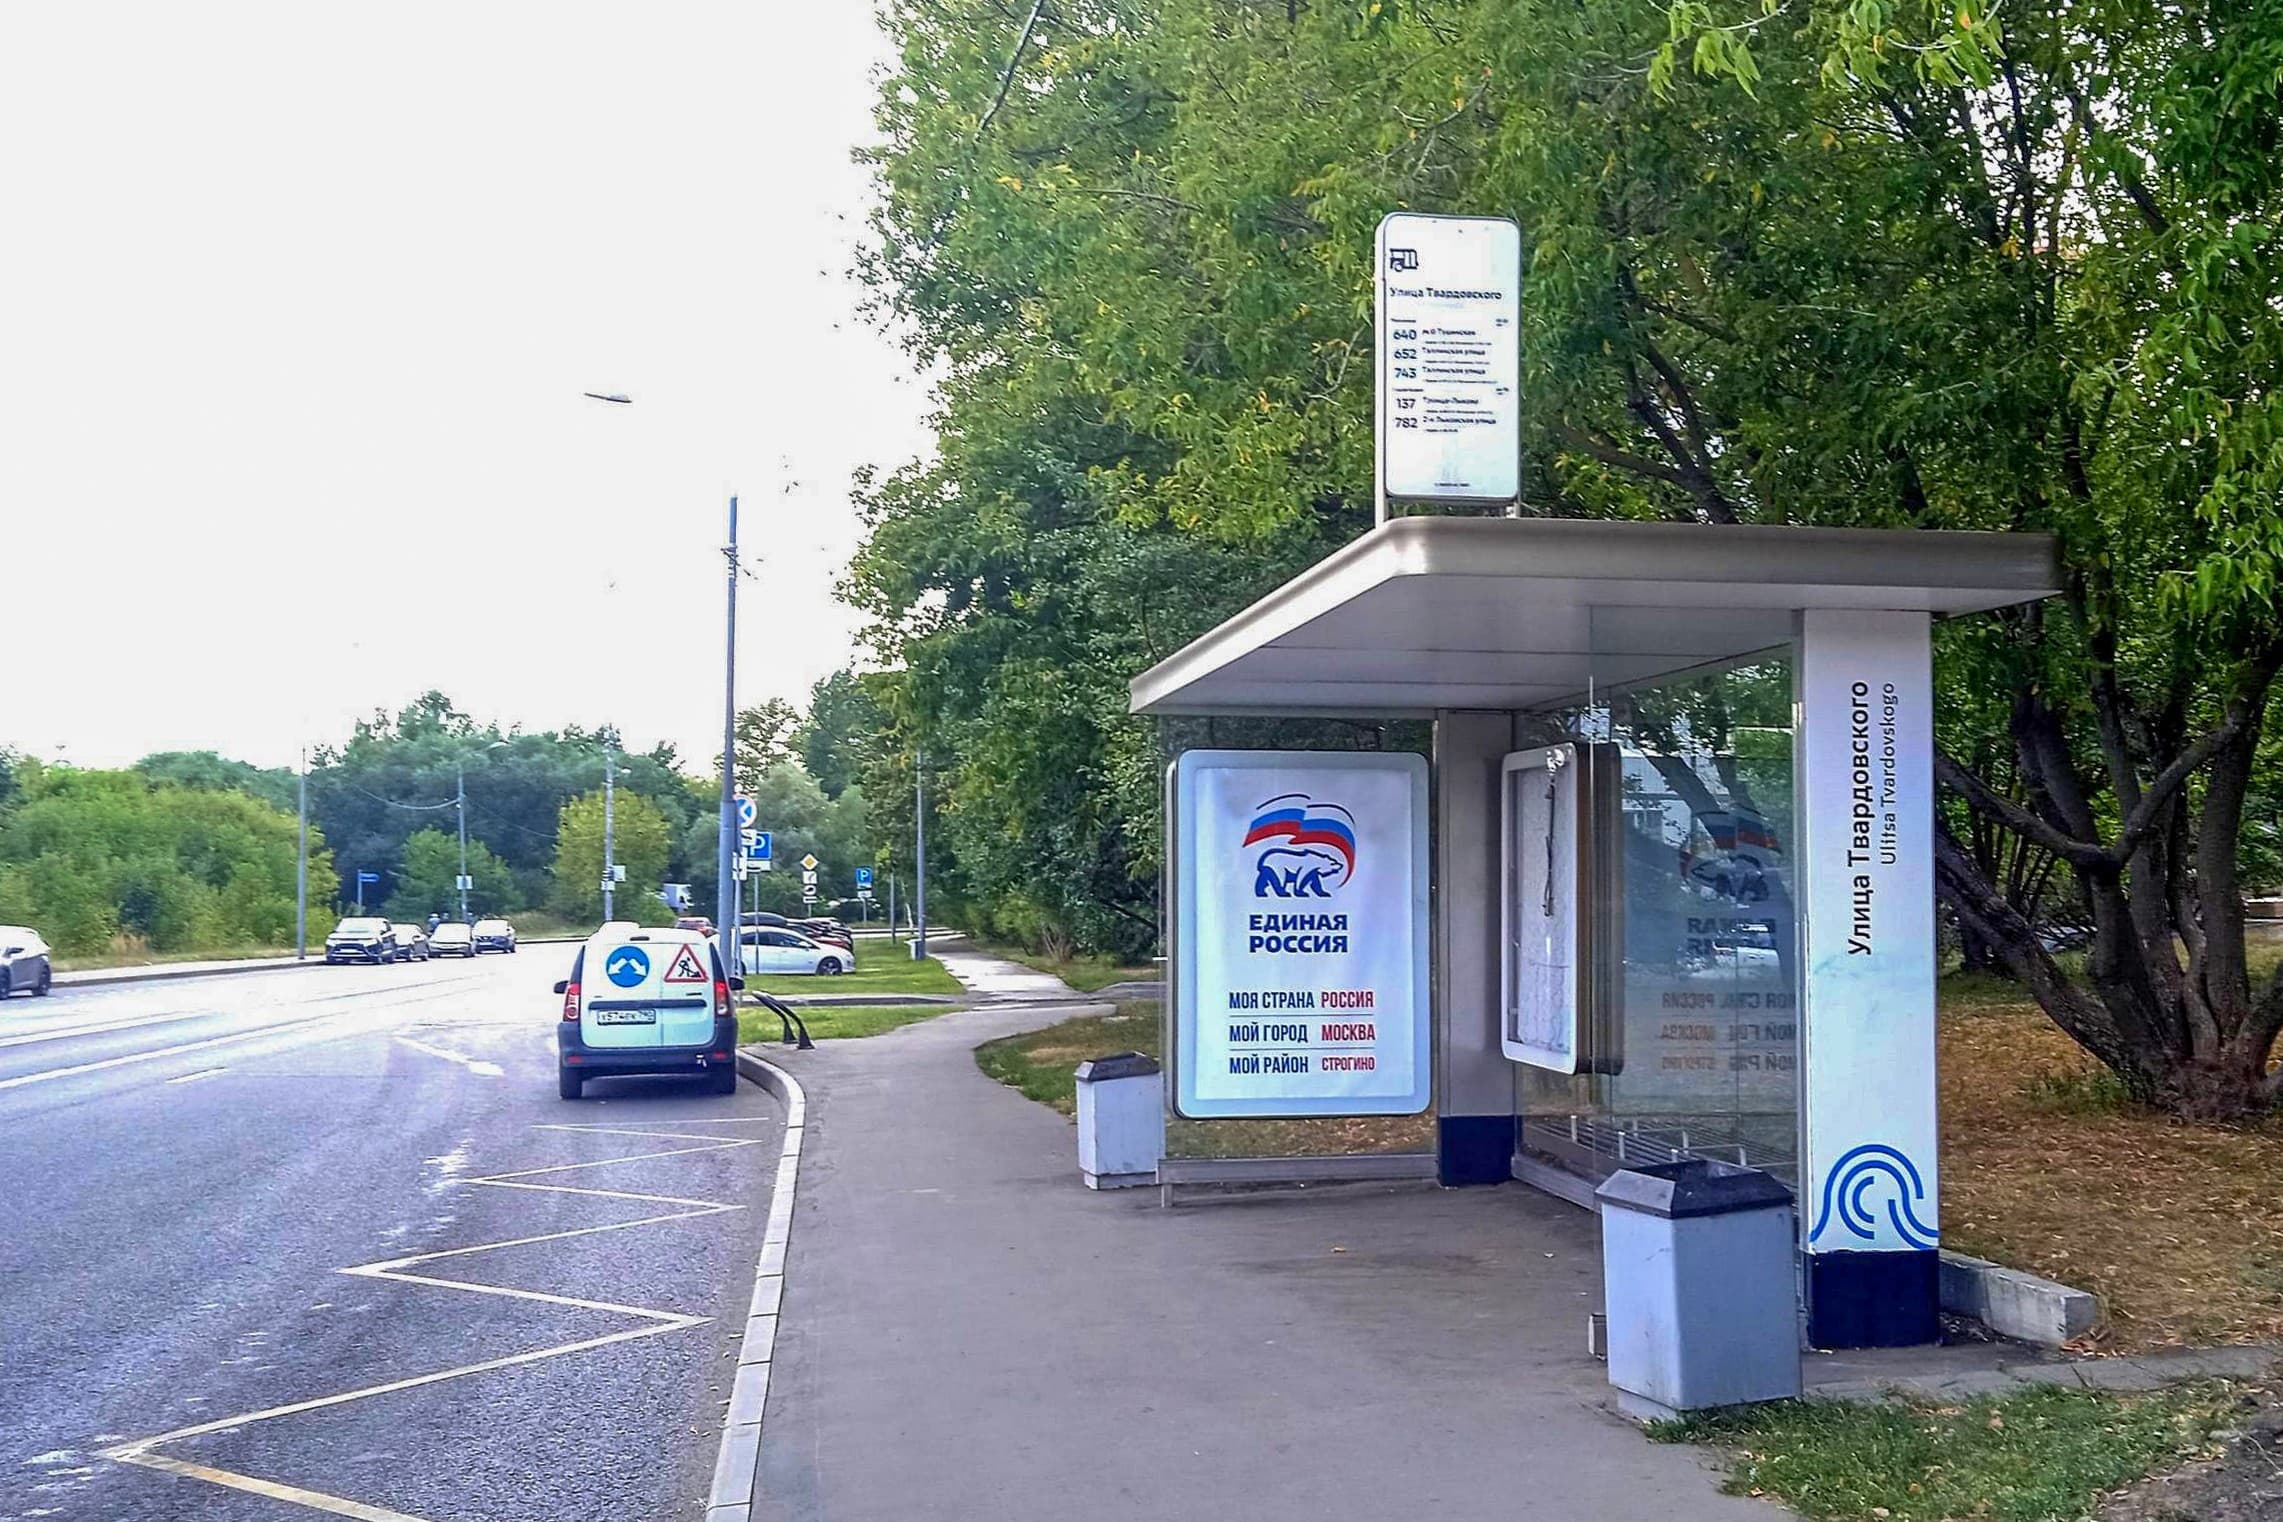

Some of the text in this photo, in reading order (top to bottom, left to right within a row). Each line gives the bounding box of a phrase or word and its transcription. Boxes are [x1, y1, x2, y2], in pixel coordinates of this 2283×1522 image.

[1389, 287, 1502, 300] Улица Твардовского
[1393, 329, 1417, 340] 640
[1393, 348, 1417, 359] 652
[1394, 367, 1417, 379] 743
[1396, 398, 1416, 409] 137
[1394, 417, 1418, 428] 782
[1878, 682, 1899, 865] Ulitsa Tvardovskogo
[1847, 681, 1876, 956] Улица Твардовского
[1249, 914, 1348, 933] ЕДИНАЯ
[1249, 935, 1348, 953] РОССИЯ
[1229, 991, 1374, 1009] МОЯ СТРАНА РОССИЯ
[1229, 1022, 1376, 1043] МОЙ ГОРОД МОСКВА
[1229, 1053, 1375, 1074] МОЙ РАЙОН СТРОГИНО
